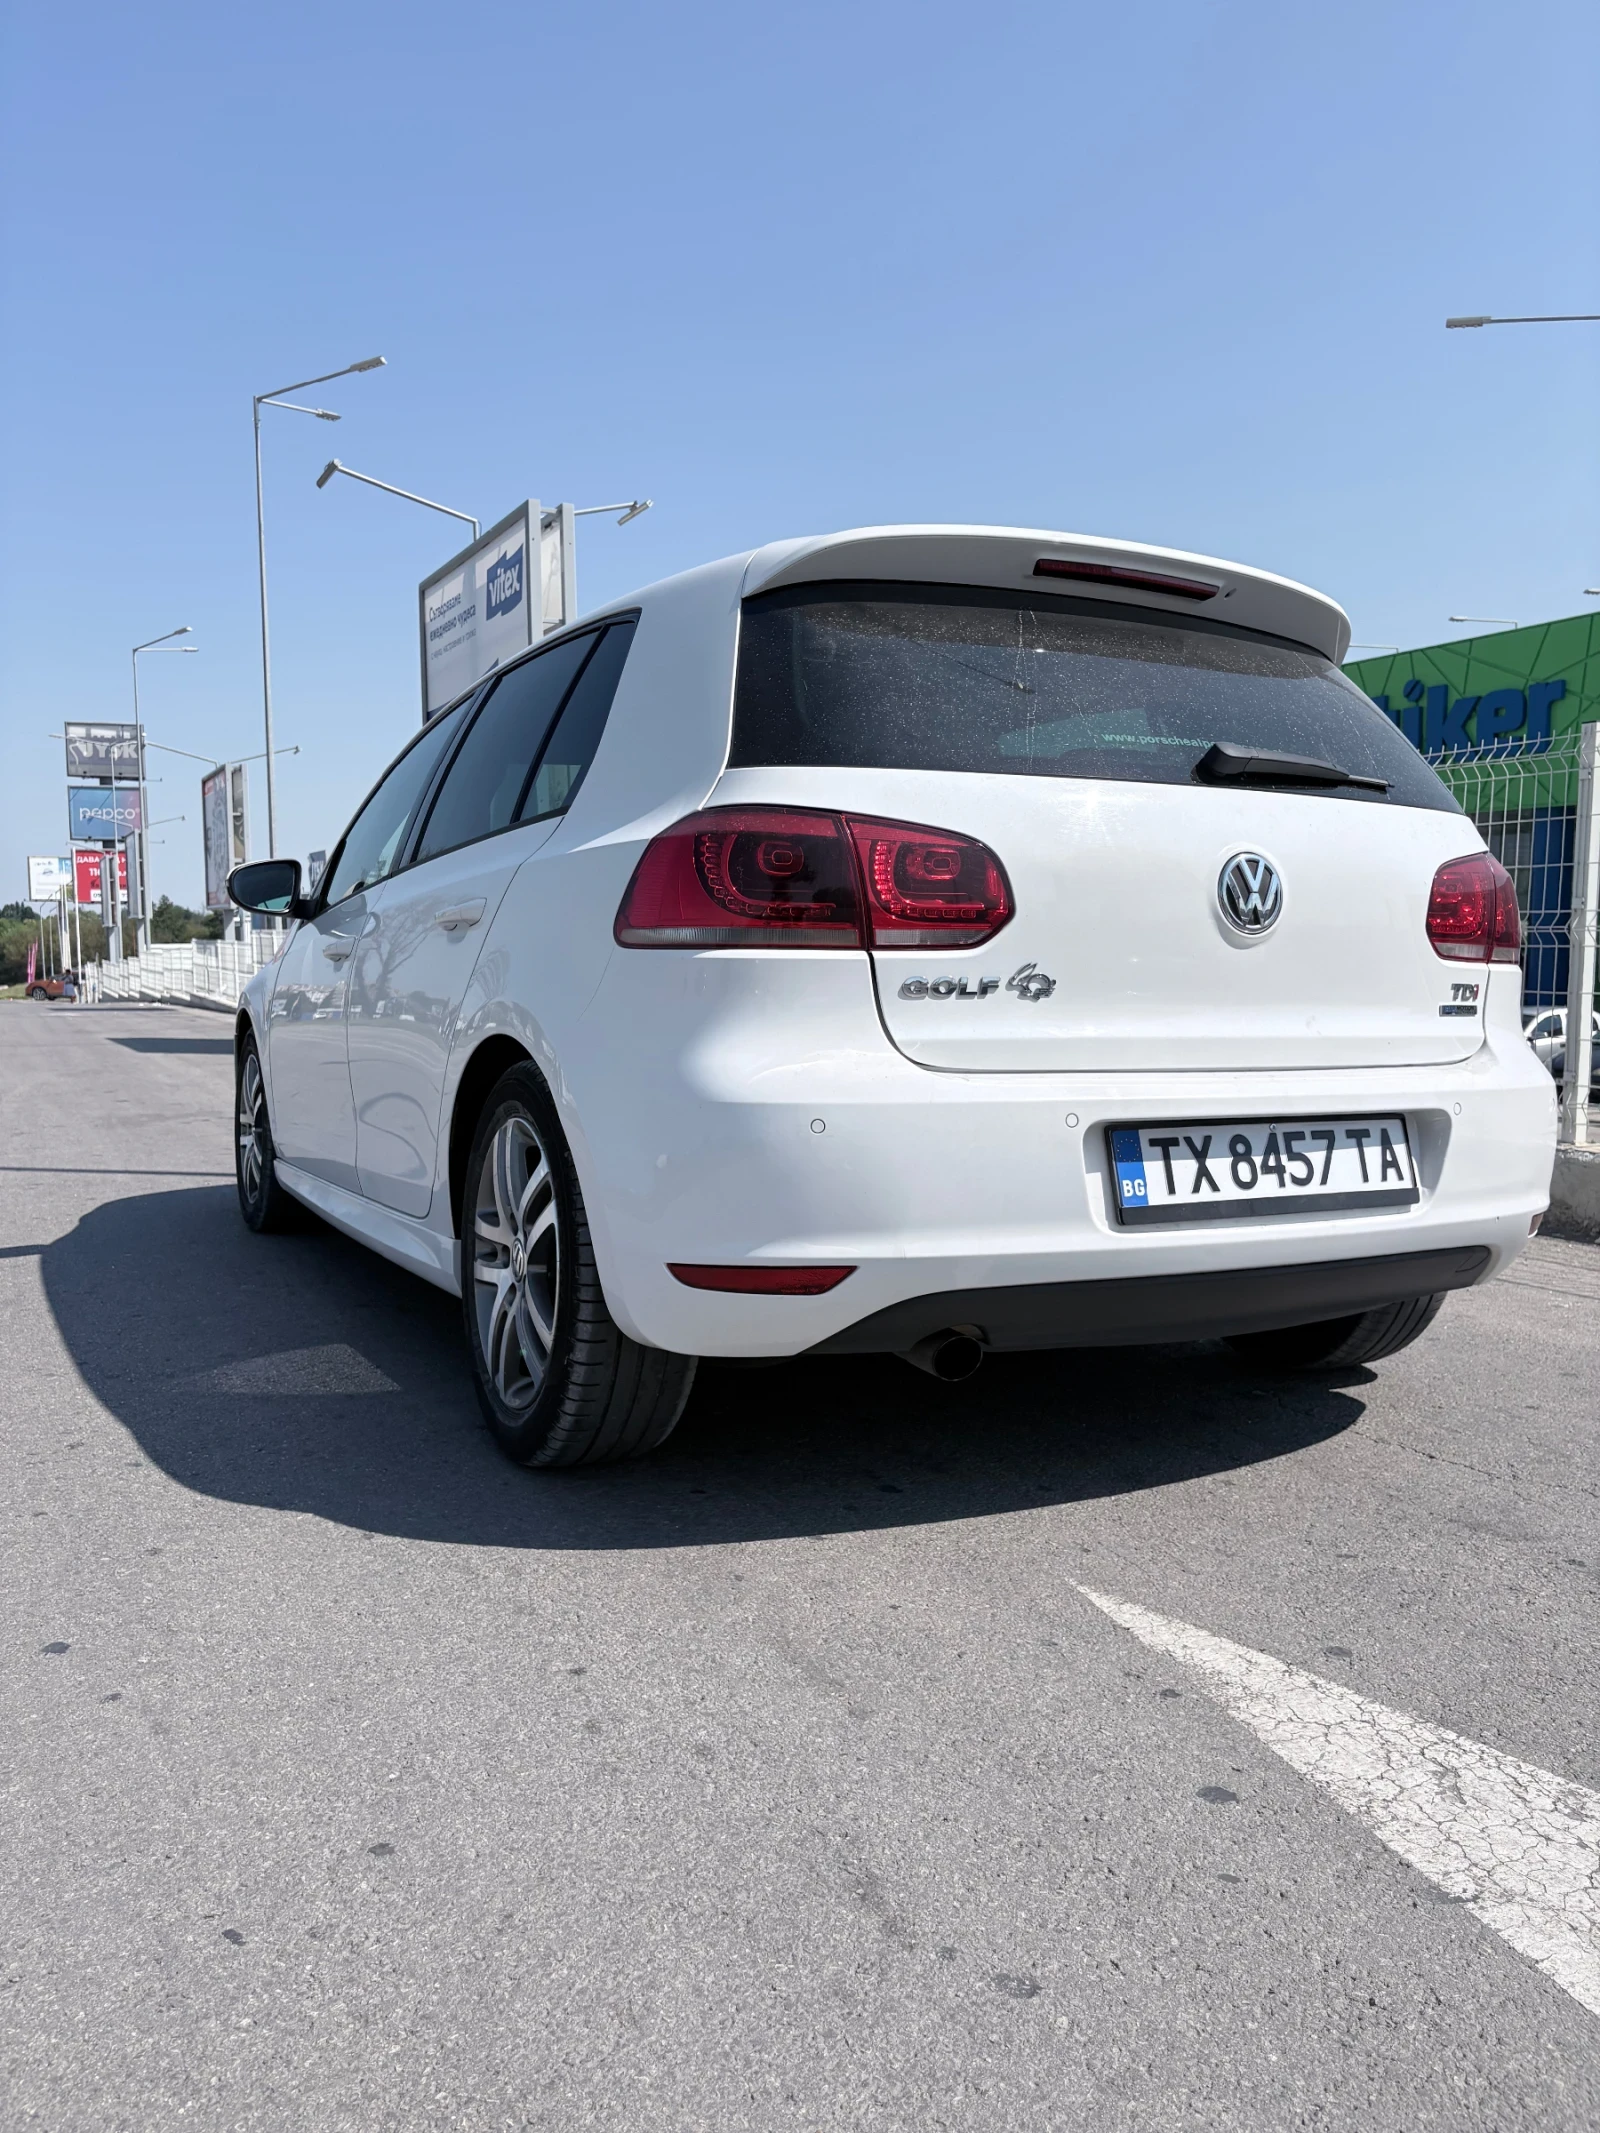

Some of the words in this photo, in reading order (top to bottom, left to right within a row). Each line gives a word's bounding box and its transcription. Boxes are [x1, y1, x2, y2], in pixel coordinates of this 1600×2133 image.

[489, 564, 520, 607] vitex
[80, 807, 136, 821] pepco
[898, 976, 1001, 1000] GOLF
[1149, 1135, 1220, 1195] TX
[1228, 1130, 1335, 1190] 8457
[1345, 1128, 1404, 1183] TA
[1122, 1180, 1146, 1197] BG
